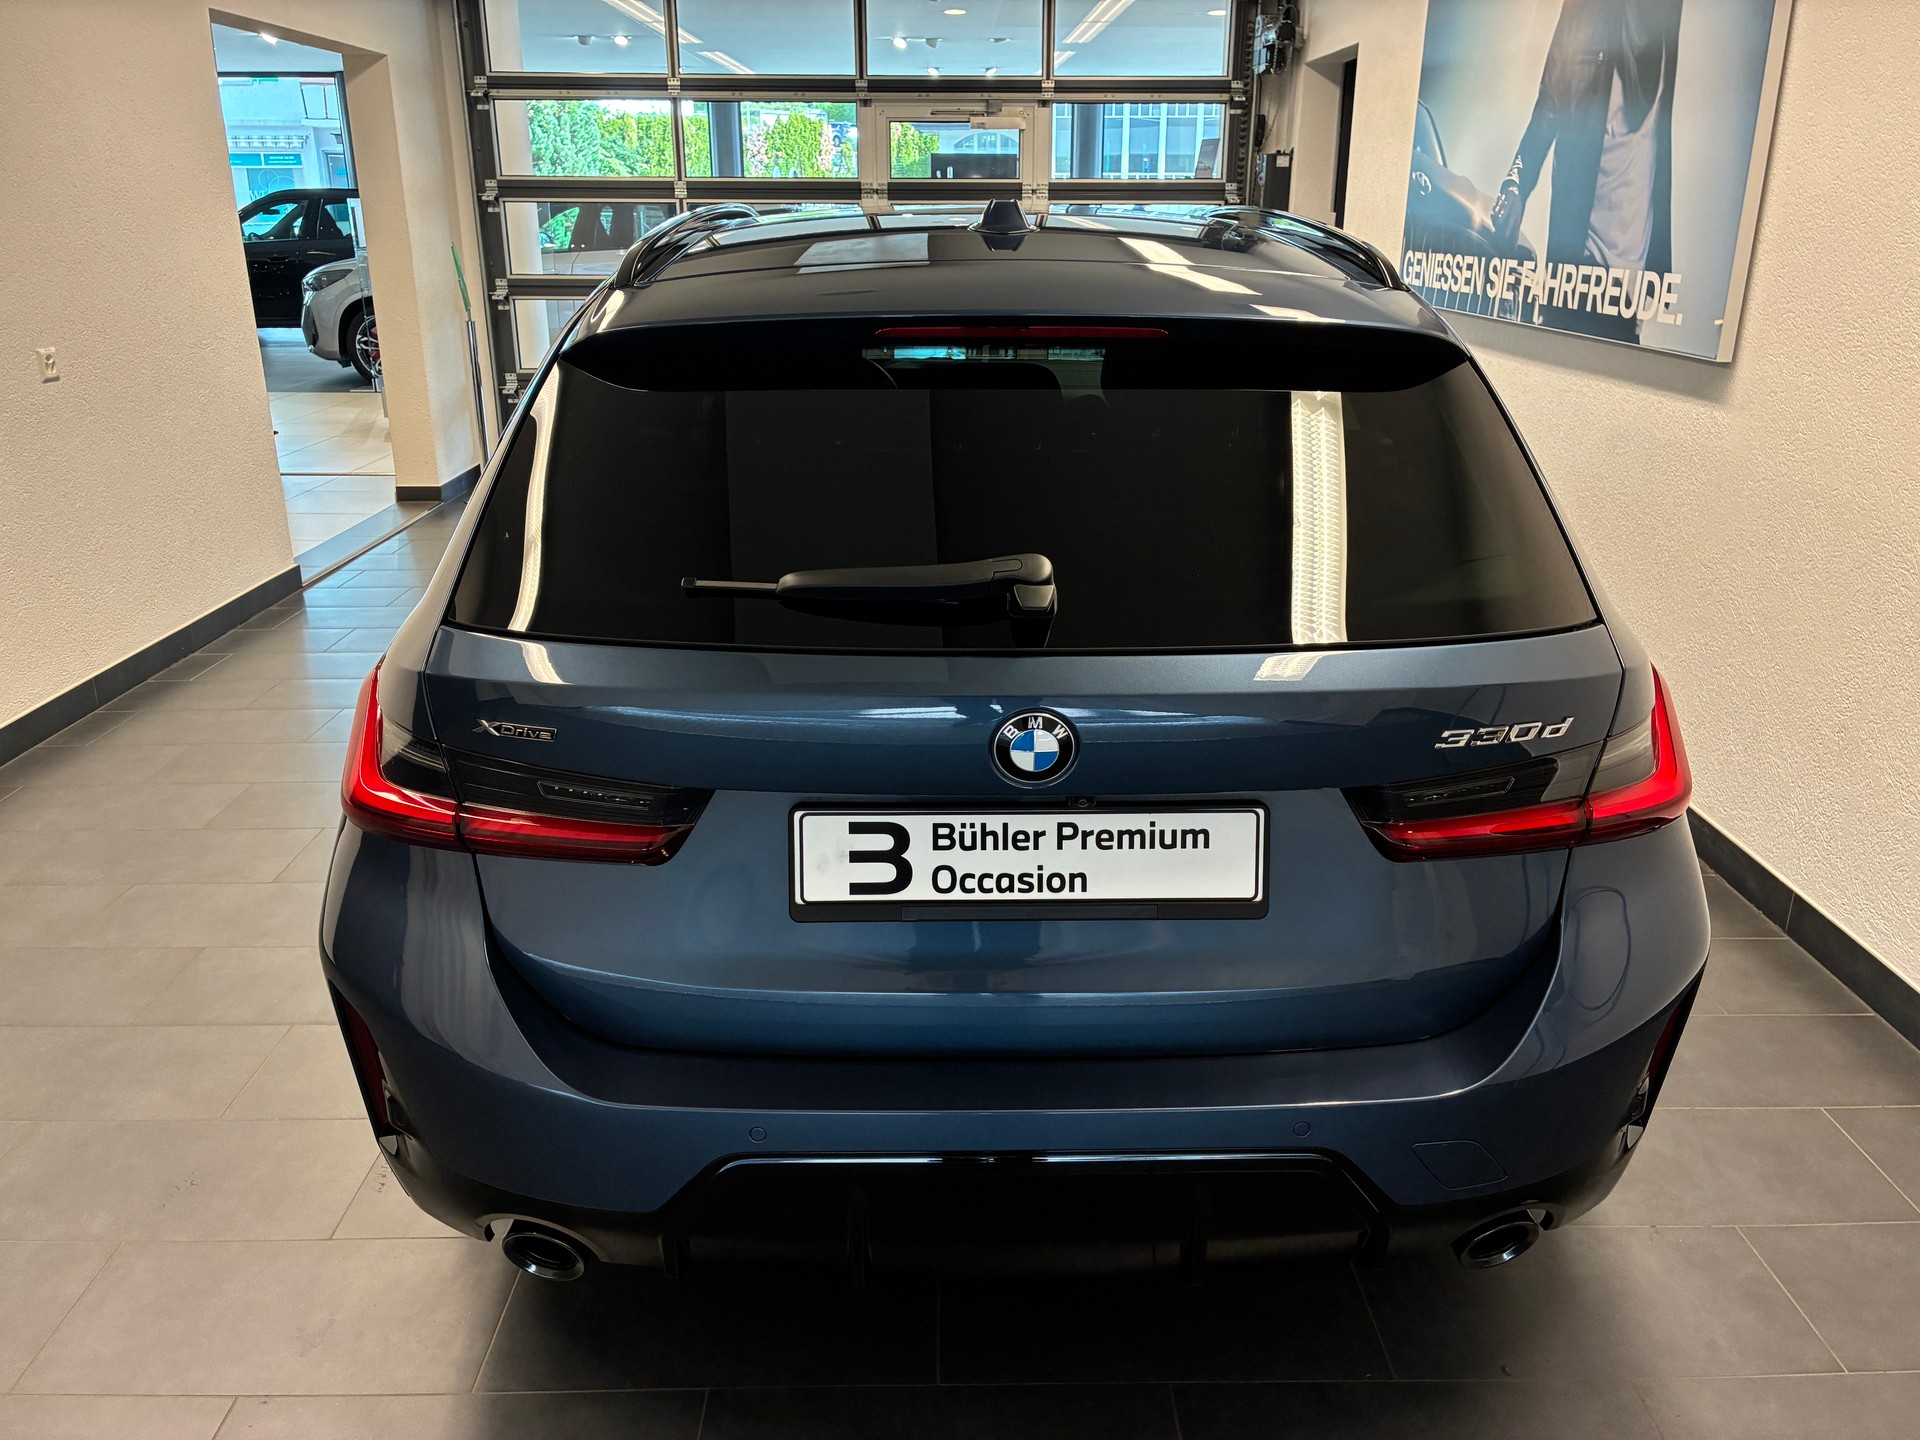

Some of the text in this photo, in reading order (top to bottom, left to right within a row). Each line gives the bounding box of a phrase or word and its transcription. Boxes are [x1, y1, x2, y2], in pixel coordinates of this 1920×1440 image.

[1403, 249, 1682, 325] GENIESSEN SIE FAHRFREUDE.
[1003, 716, 1068, 740] BMW
[1434, 717, 1575, 749] 330d
[931, 821, 1211, 852] Bühler Premium
[931, 865, 1087, 894] Occasion
